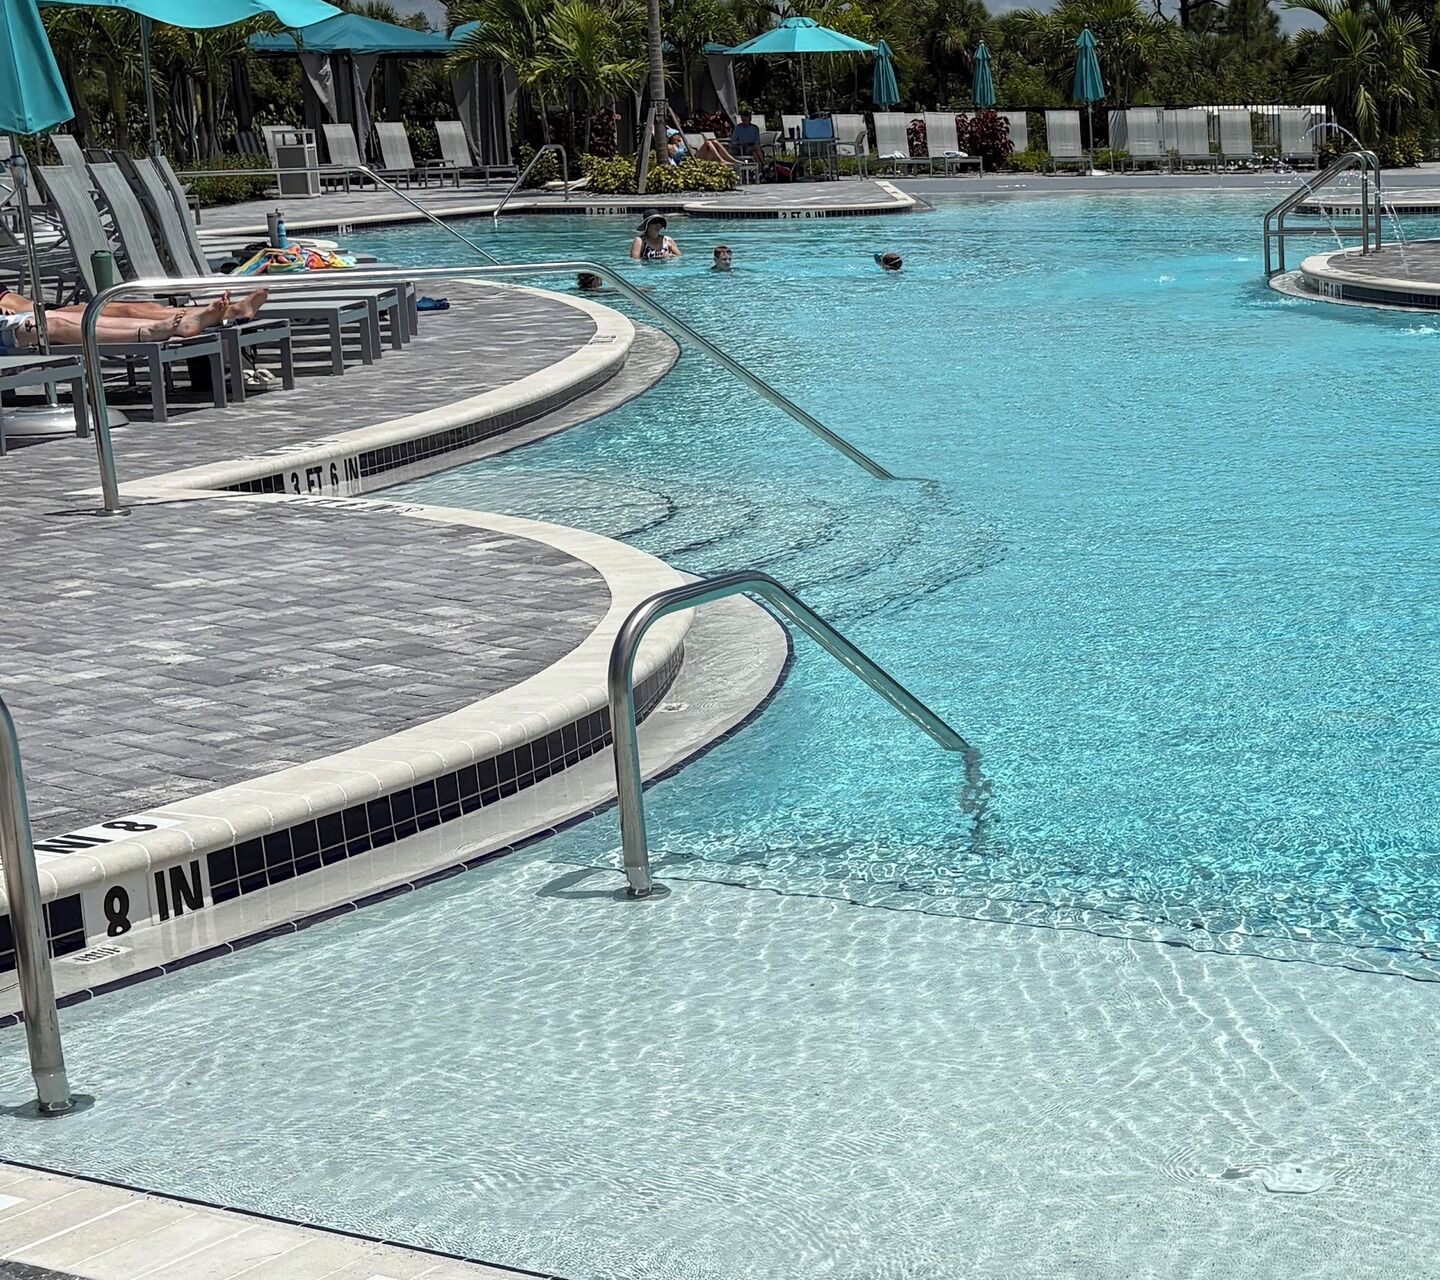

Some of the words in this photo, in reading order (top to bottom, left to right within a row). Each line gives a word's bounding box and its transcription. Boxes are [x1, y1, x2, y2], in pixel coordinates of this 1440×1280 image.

[306, 465, 323, 493] FT
[330, 462, 339, 486] 6
[343, 456, 360, 481] IN
[103, 885, 133, 937] 8
[154, 859, 205, 922] IN
